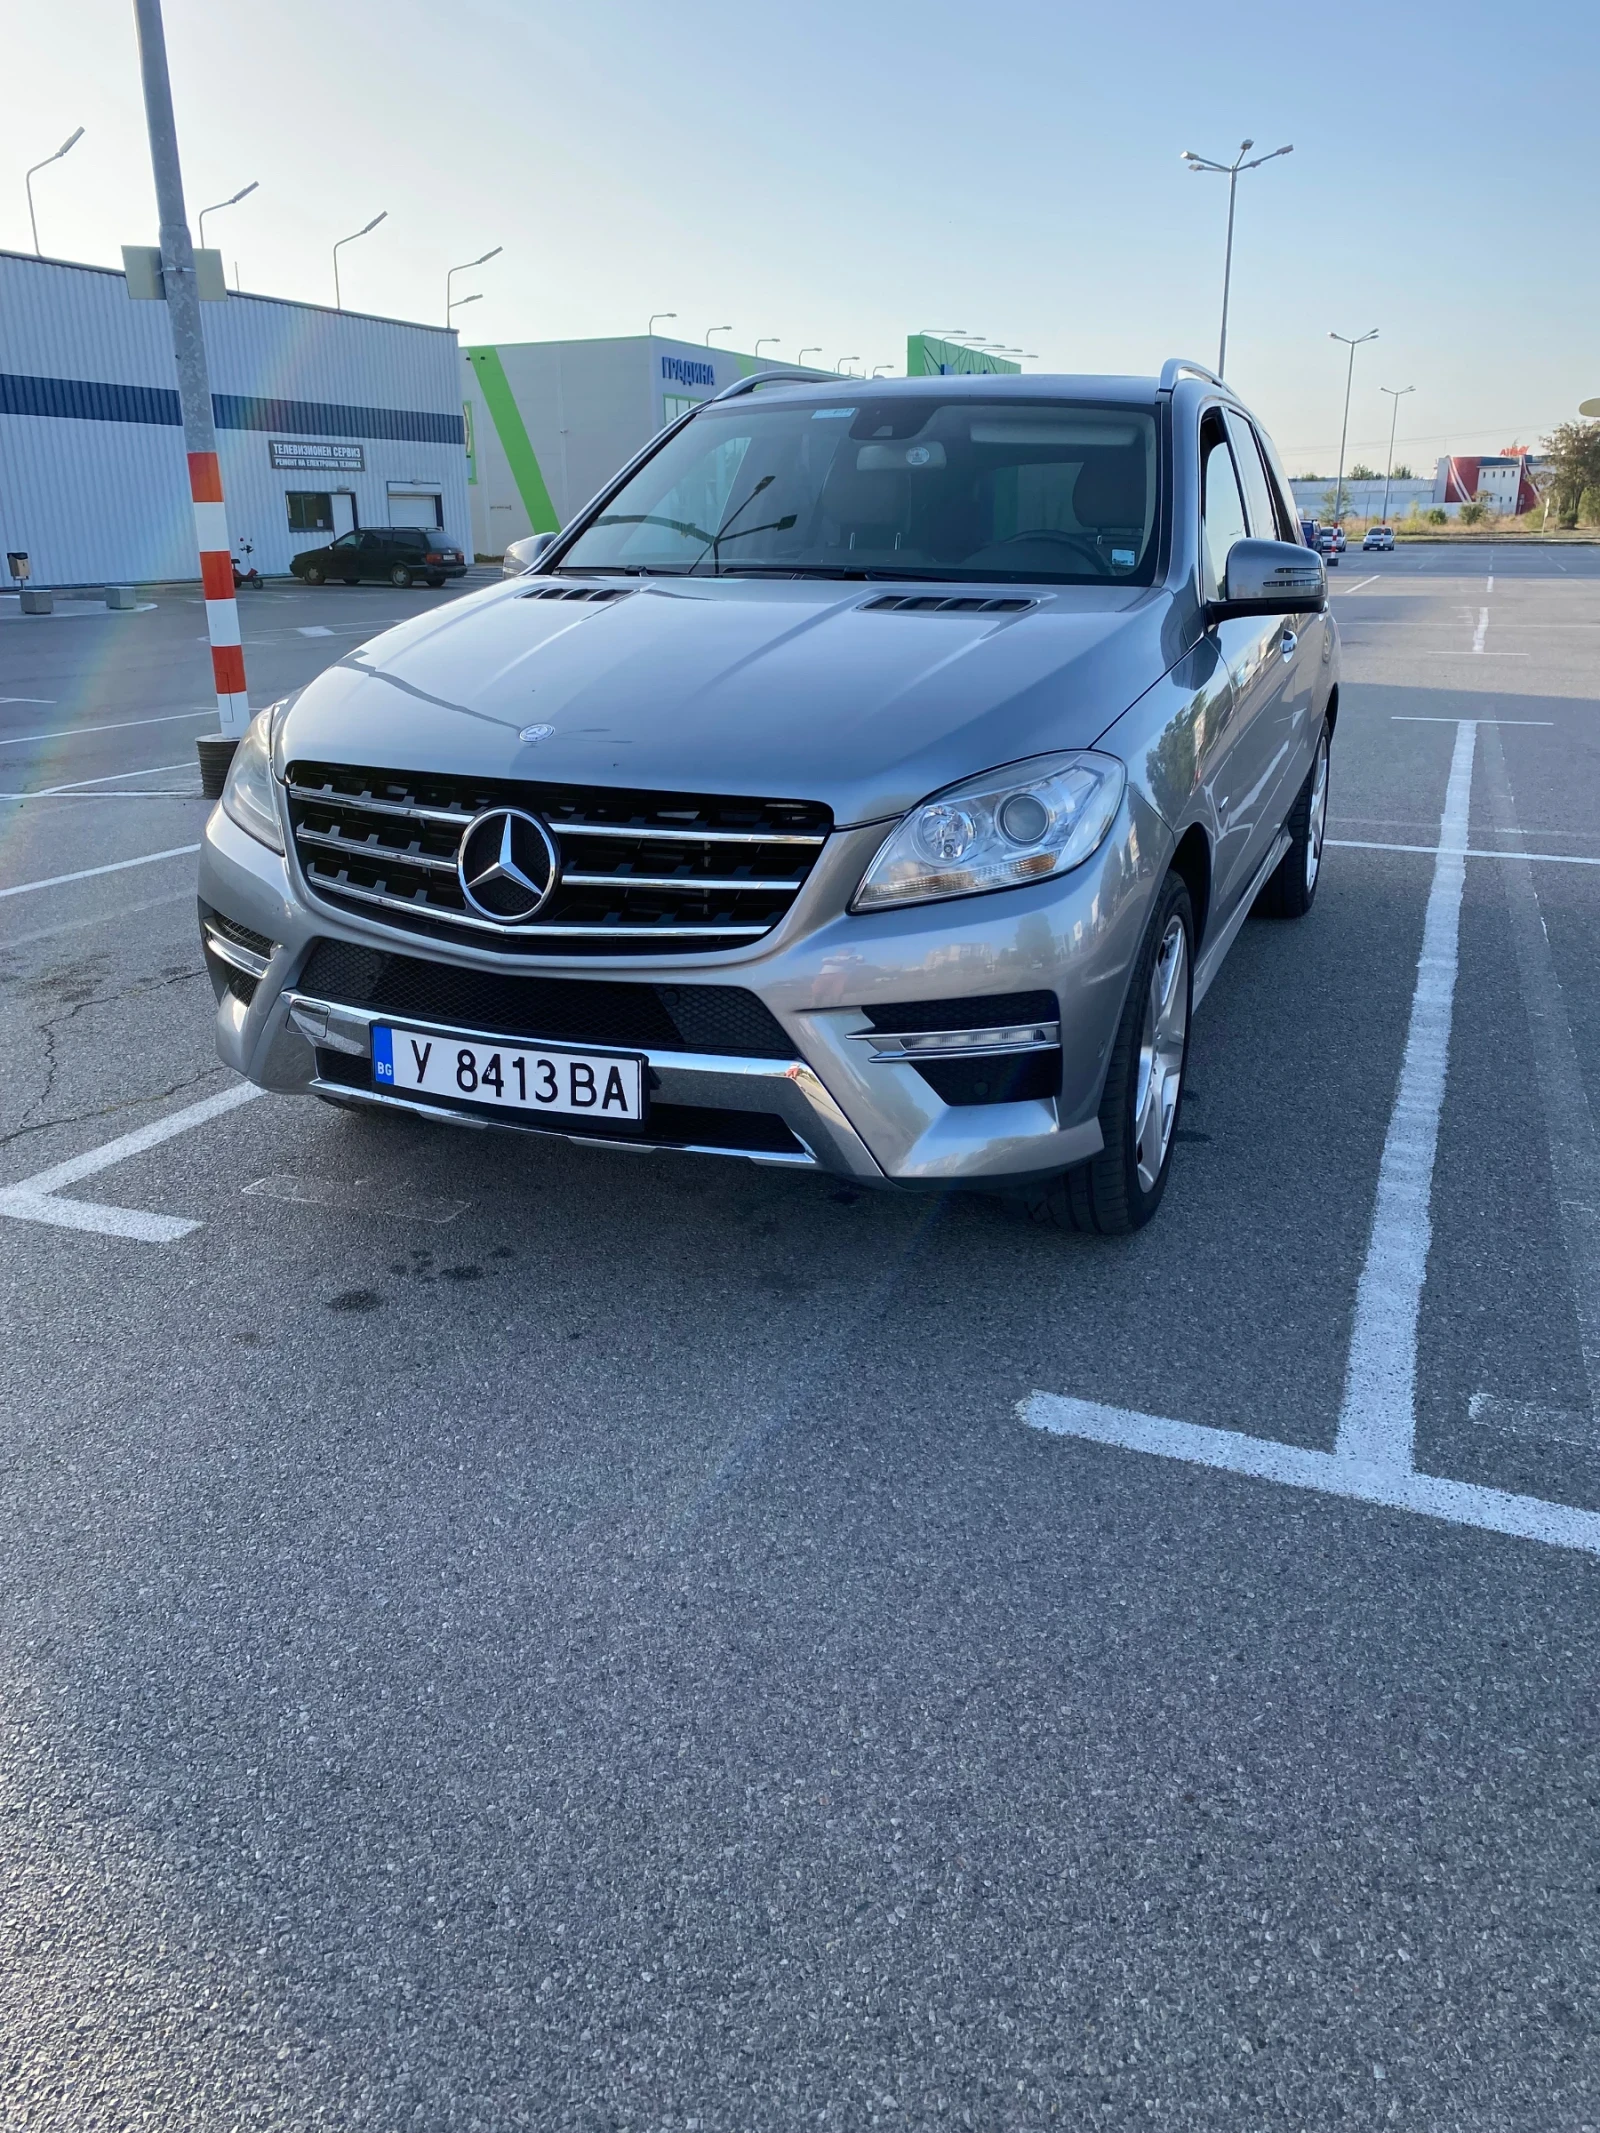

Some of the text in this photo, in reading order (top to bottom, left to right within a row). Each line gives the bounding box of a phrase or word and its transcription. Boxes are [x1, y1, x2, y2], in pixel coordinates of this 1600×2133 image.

[662, 356, 715, 386] ГРАДИНА
[273, 443, 361, 458] ТЕЛЕВИЗИОНЕН СЕРВИЗ
[275, 458, 297, 466] РЕМОНТ
[298, 459, 306, 467] НА
[377, 1061, 393, 1076] BG
